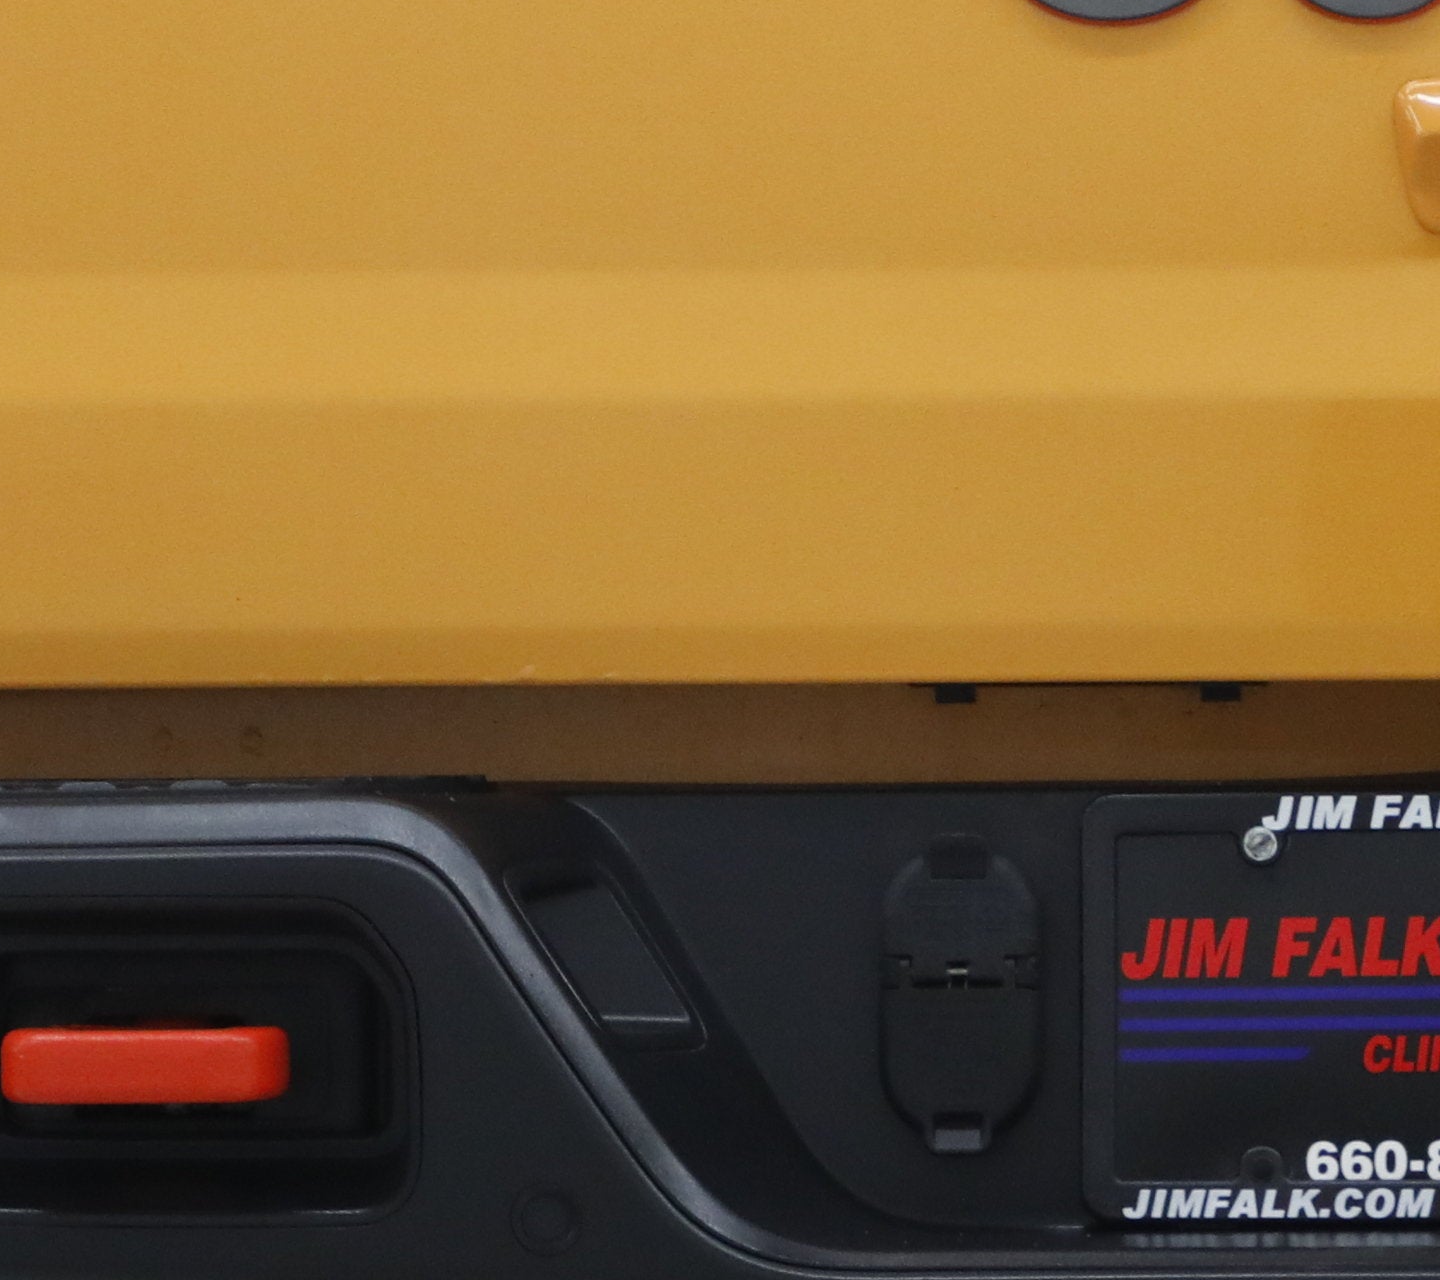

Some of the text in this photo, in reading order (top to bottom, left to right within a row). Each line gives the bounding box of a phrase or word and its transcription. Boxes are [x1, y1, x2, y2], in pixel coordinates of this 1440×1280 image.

[1261, 796, 1356, 832] JIM
[1120, 918, 1251, 980] JIM
[1121, 1189, 1434, 1221] JIMFALK.COM
